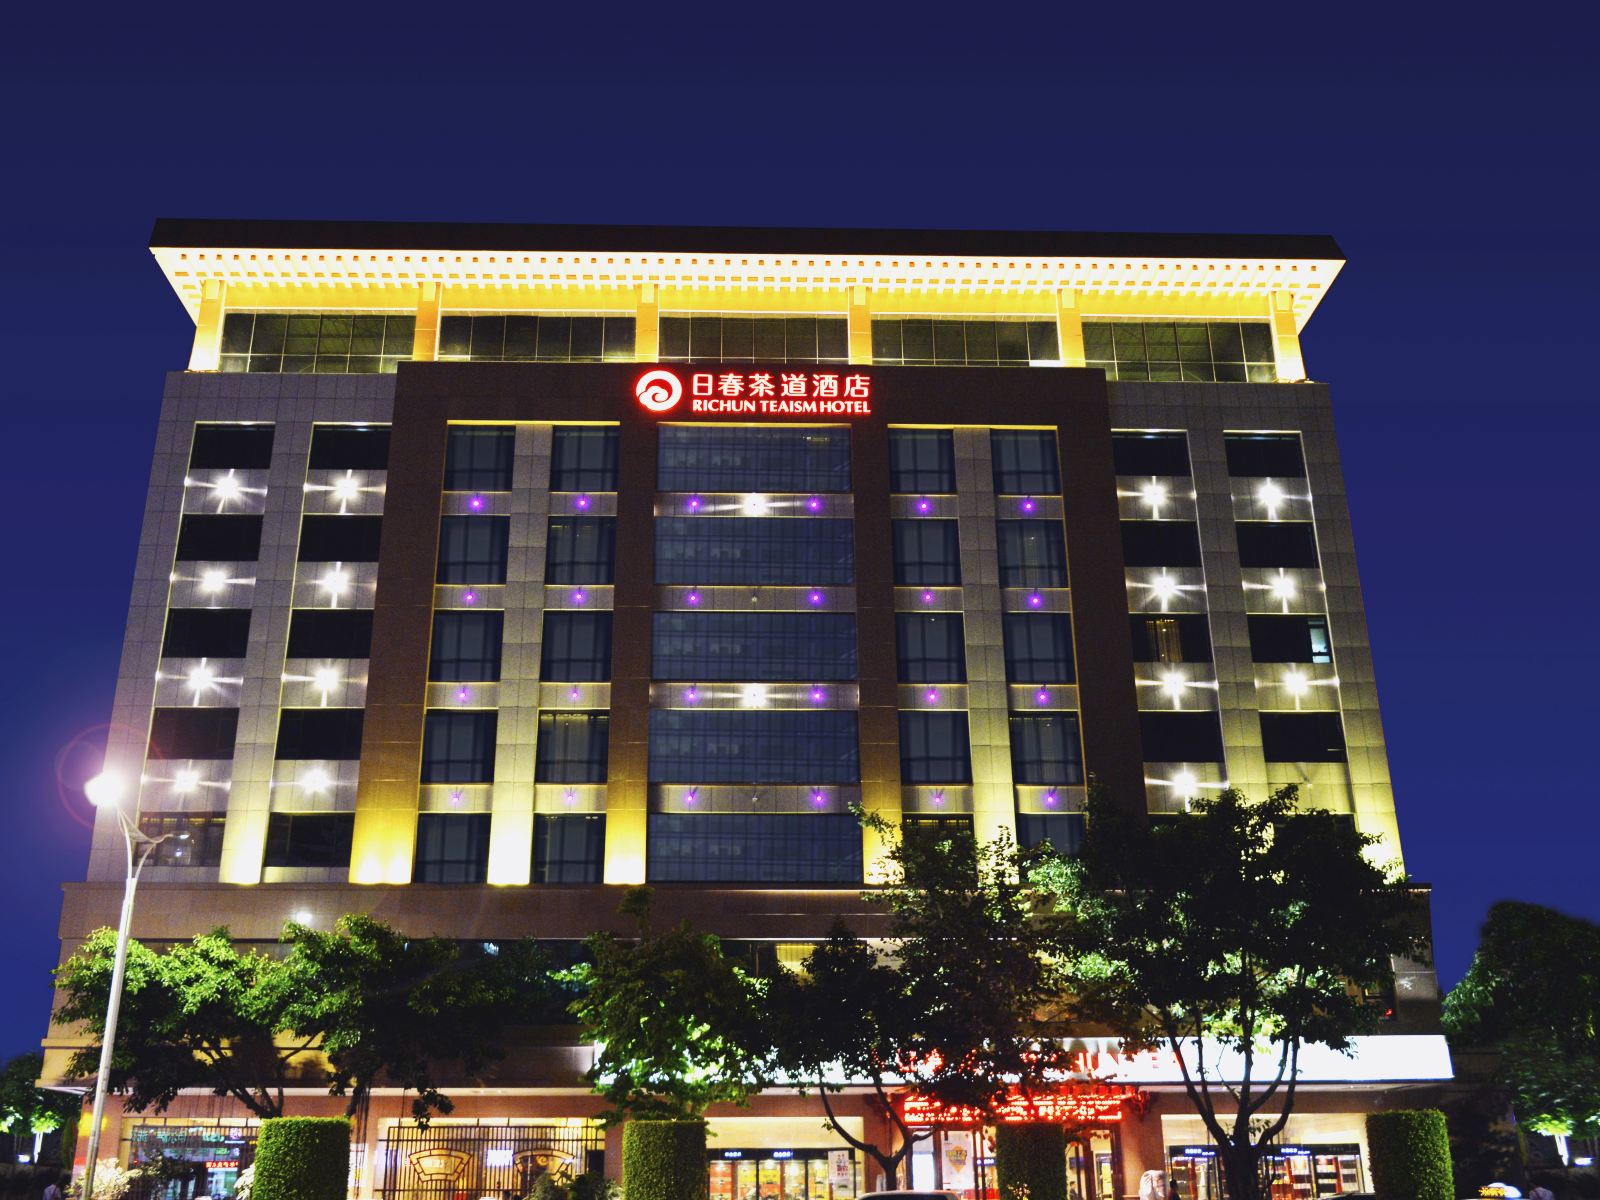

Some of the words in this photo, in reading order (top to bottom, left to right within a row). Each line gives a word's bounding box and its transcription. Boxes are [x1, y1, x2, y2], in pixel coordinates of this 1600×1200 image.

[692, 372, 871, 398] 日春茶道酒店
[692, 399, 756, 412] RICHUN
[759, 400, 817, 413] TEAISM
[820, 400, 871, 413] HOTEL
